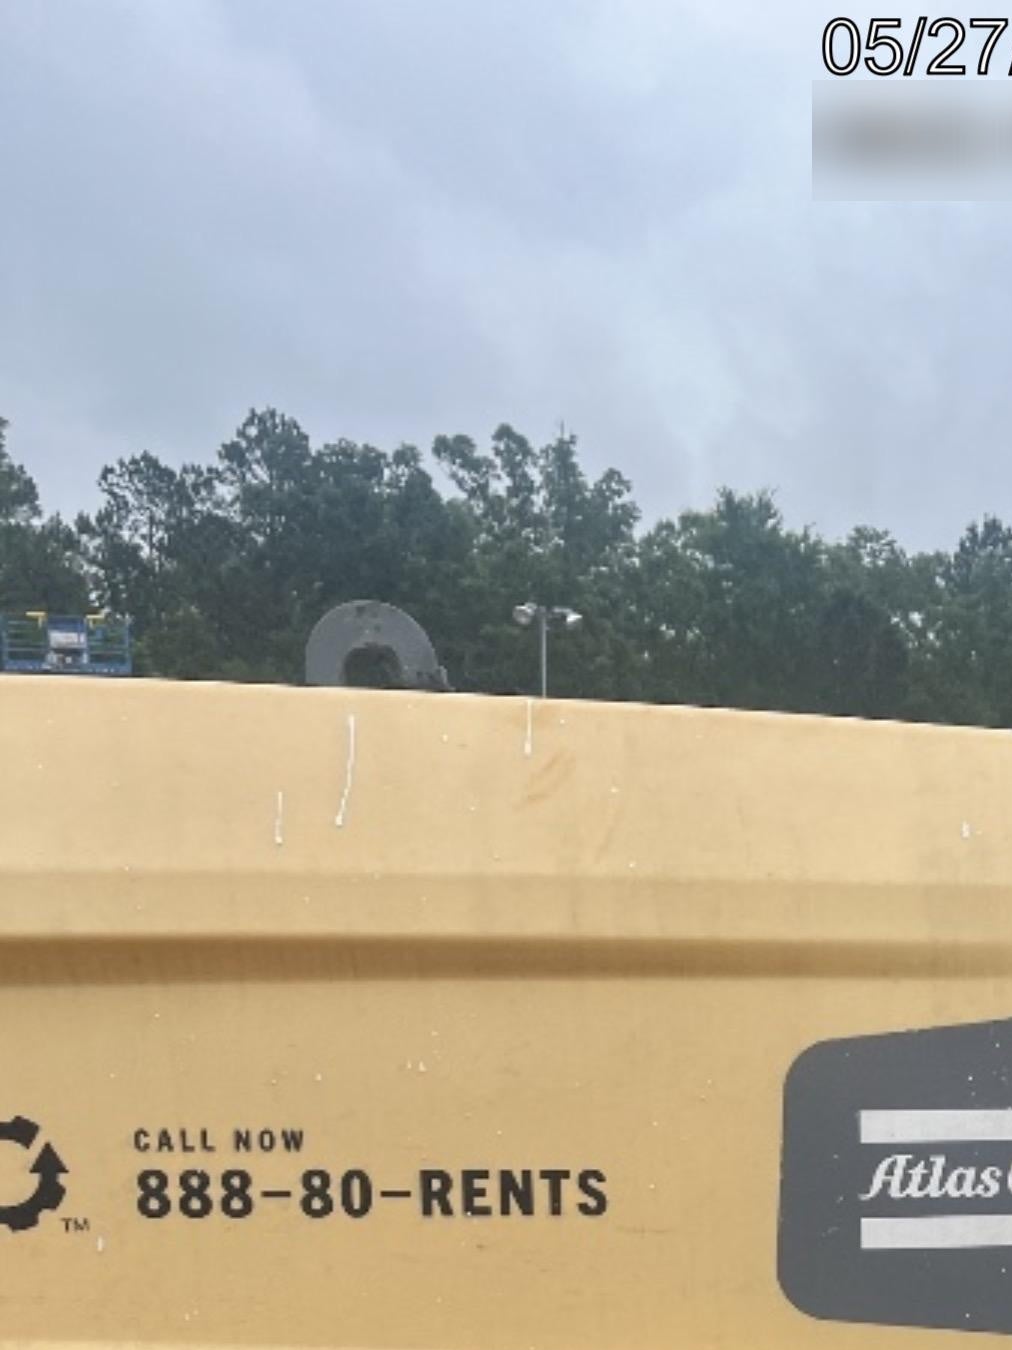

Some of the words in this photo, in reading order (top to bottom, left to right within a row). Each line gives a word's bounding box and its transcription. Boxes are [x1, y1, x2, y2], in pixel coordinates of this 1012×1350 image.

[133, 1128, 216, 1153] CALL
[233, 1128, 305, 1153] NOW
[135, 1168, 609, 1219] 888-80-RENTS
[859, 1153, 1002, 1201] Atlas
[61, 1217, 91, 1233] TM
